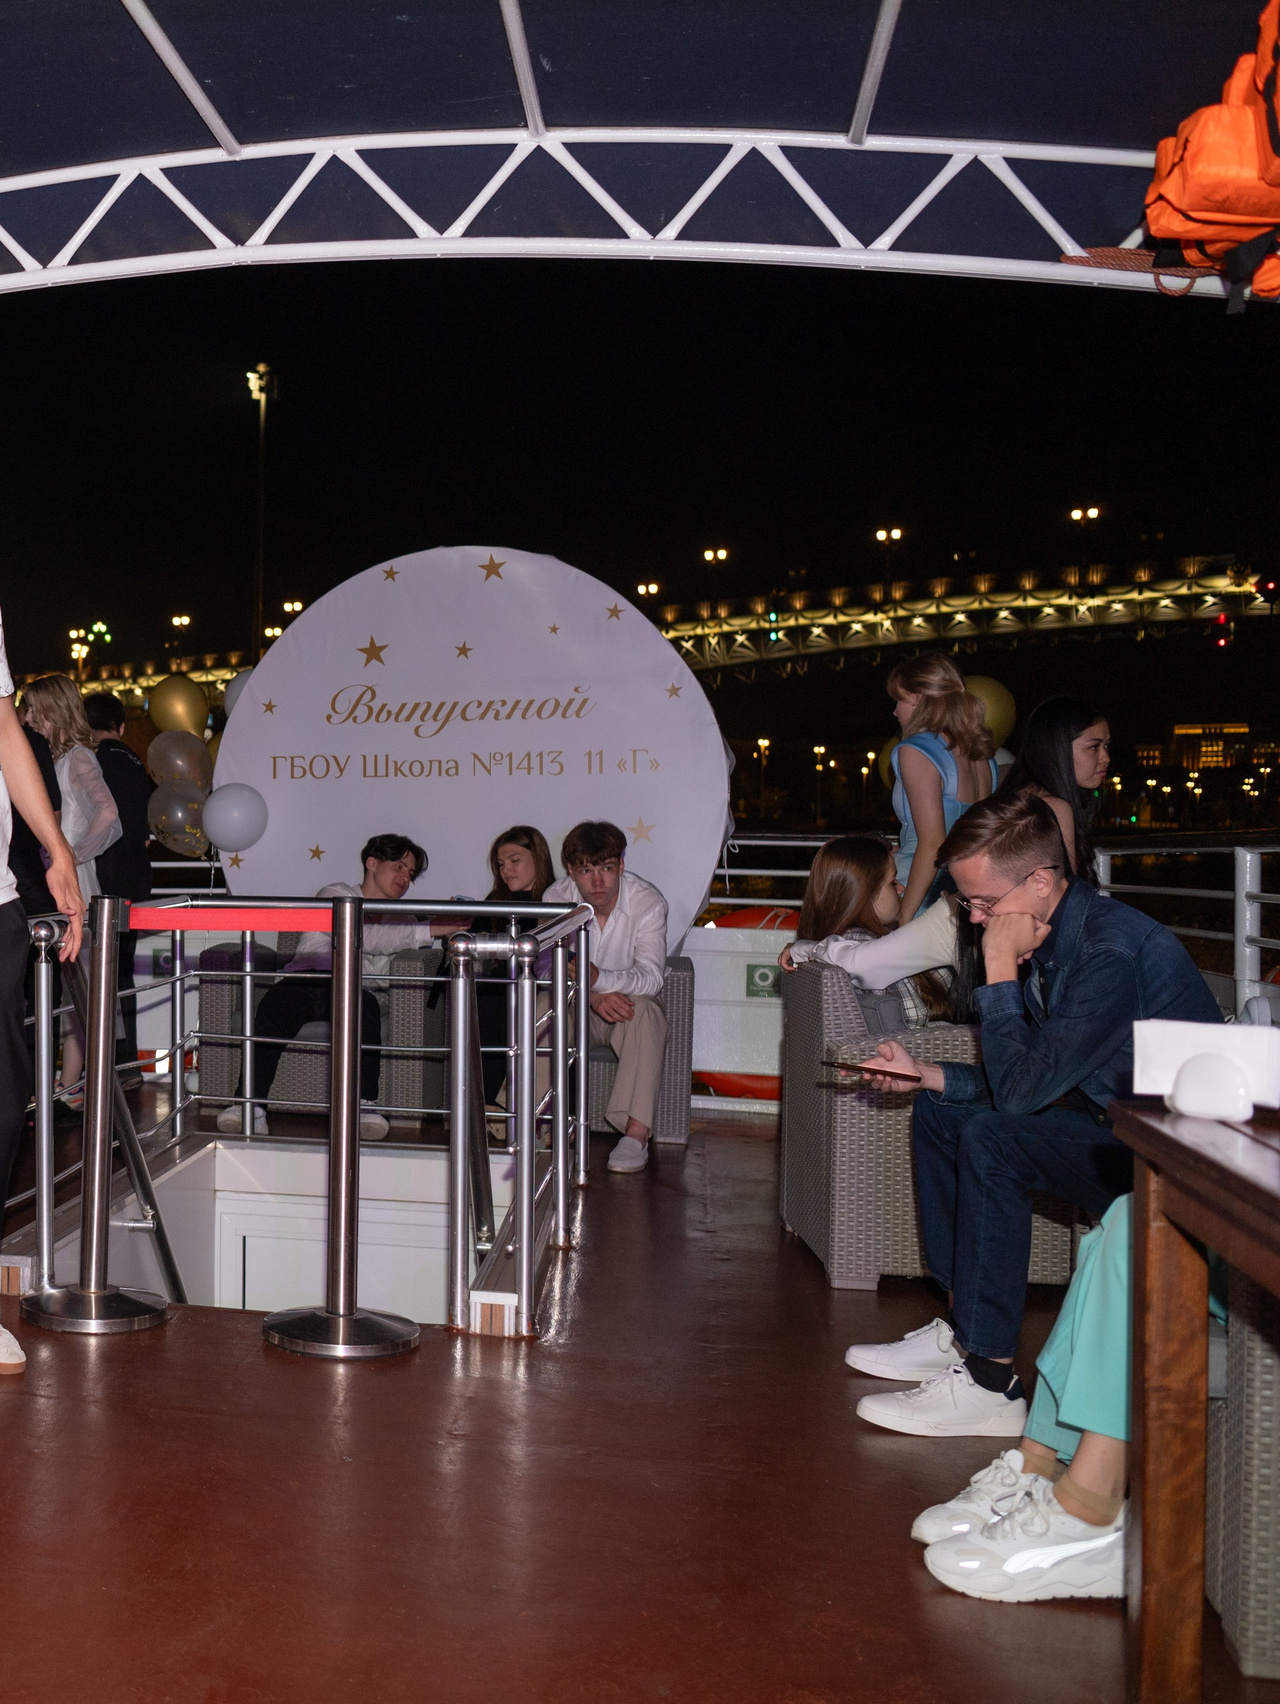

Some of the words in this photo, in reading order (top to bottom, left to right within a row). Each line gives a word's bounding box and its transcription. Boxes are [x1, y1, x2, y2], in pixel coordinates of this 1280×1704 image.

[325, 683, 597, 739] Выпускной
[270, 754, 351, 780] ГБОУ
[360, 754, 460, 779] Школа
[584, 749, 604, 775] 11
[616, 748, 661, 775] «Г»
